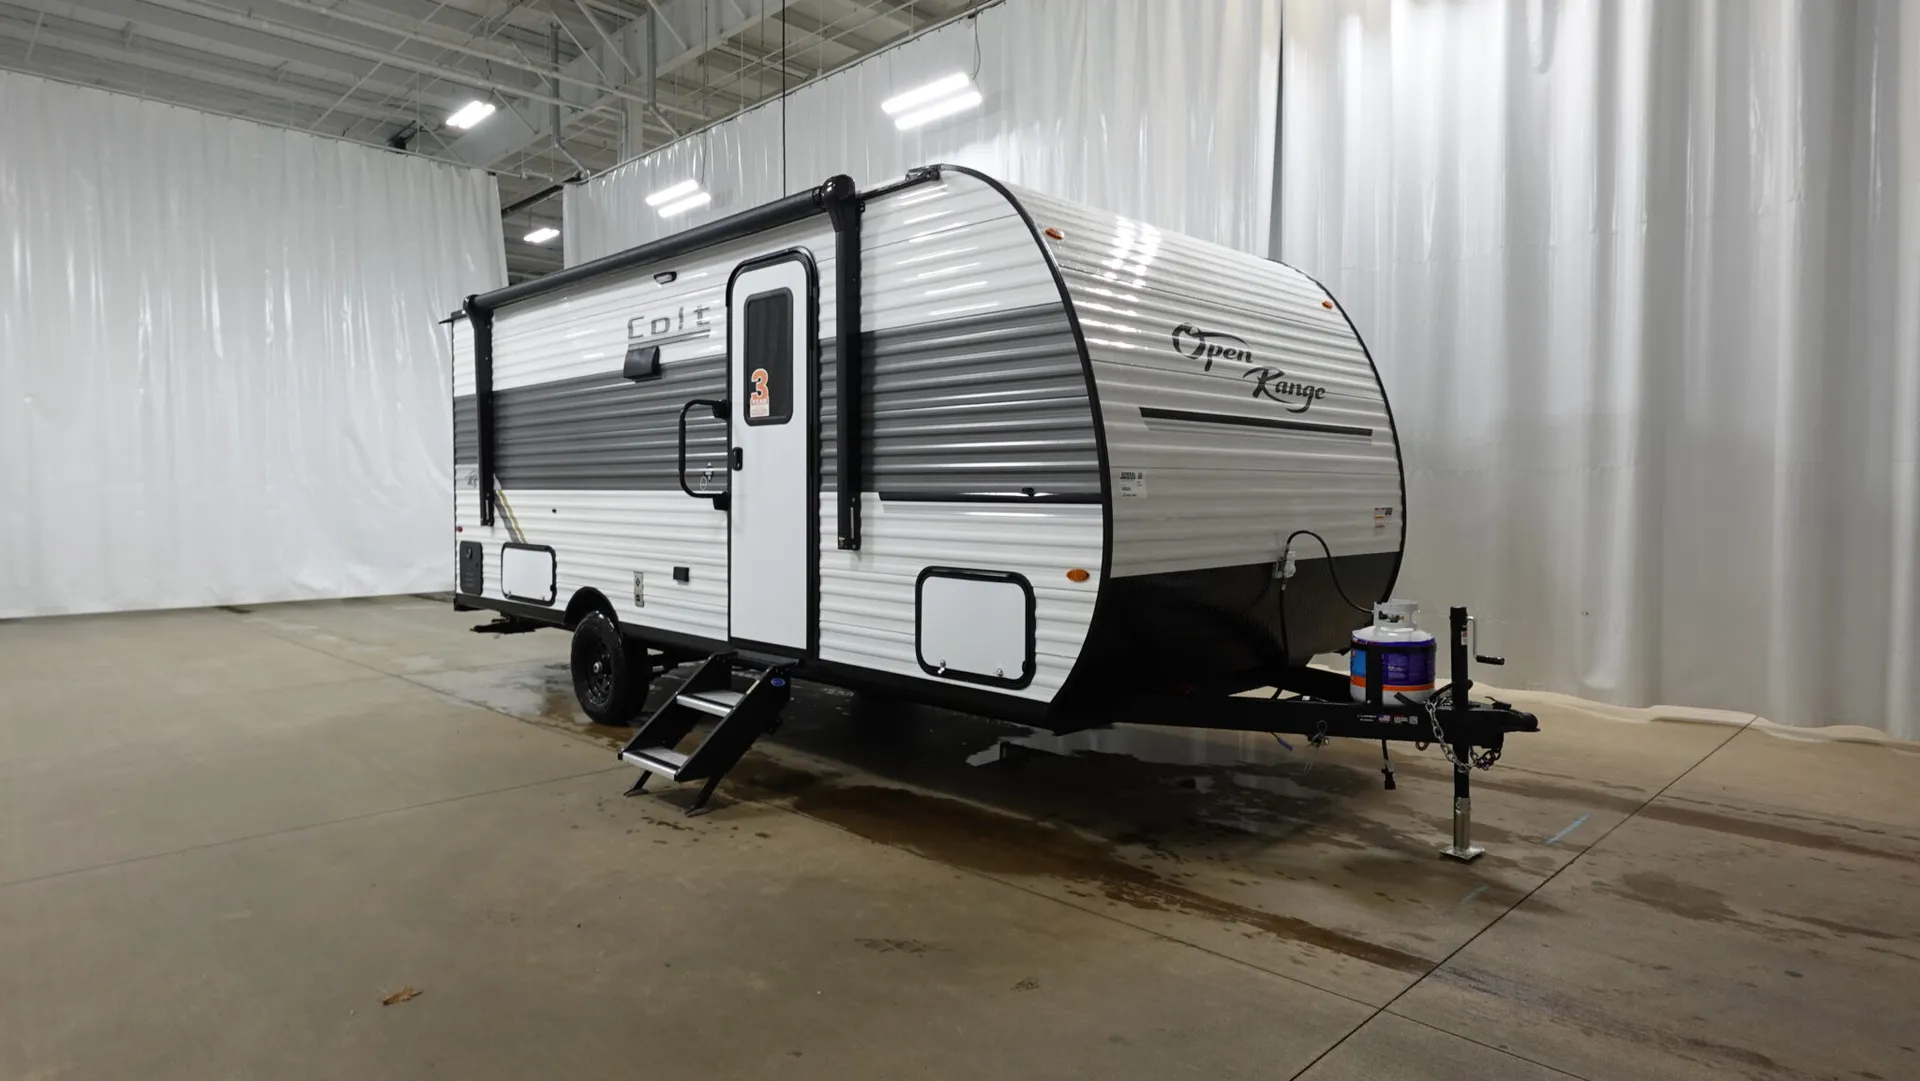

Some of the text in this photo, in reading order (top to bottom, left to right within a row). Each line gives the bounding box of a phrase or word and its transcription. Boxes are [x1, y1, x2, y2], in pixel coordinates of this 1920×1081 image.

[627, 305, 711, 340] Colt
[1172, 322, 1253, 371] Open
[751, 368, 769, 400] 3
[1242, 366, 1326, 414] Range
